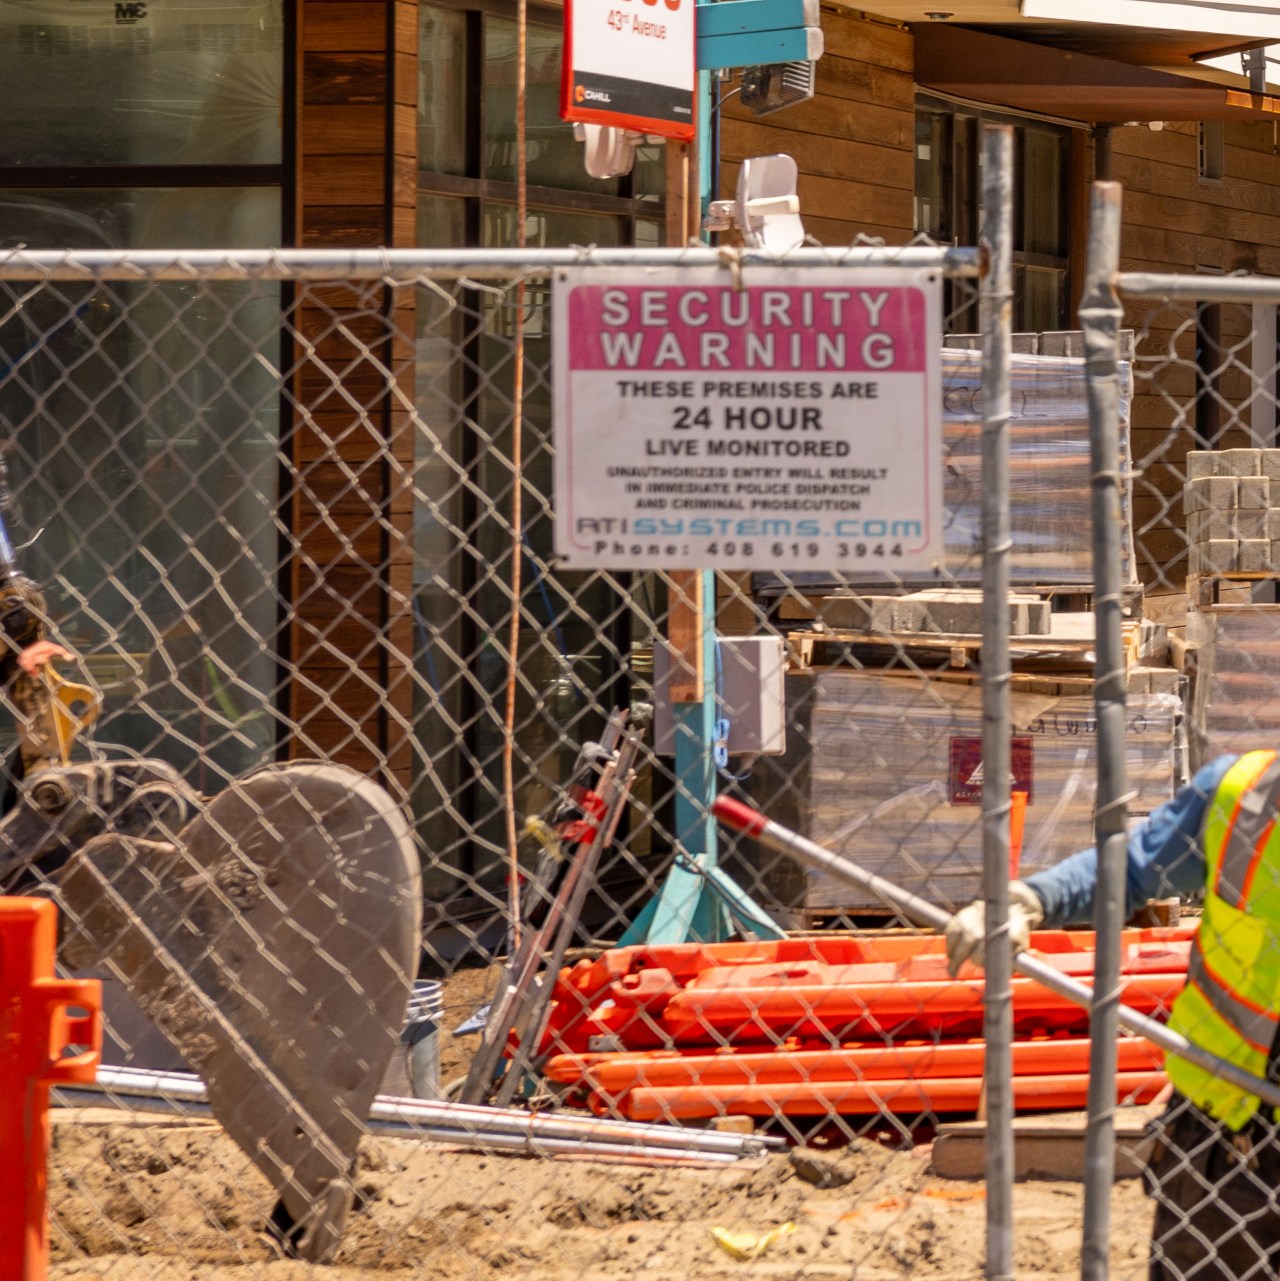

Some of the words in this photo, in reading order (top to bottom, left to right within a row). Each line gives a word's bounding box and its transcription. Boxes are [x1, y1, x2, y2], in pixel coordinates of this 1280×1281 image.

[632, 14, 666, 40] Avenue
[600, 291, 891, 327] SECURITY
[600, 331, 896, 369] WARNING
[616, 380, 695, 398] THESE
[703, 381, 823, 398] PREMISES
[830, 382, 879, 398] ARE
[672, 406, 712, 430] 24
[724, 406, 823, 430] HOUR
[645, 439, 699, 456] LIVE
[707, 440, 851, 457] MONITORED
[606, 466, 728, 478] UNAUTHORIZED
[733, 467, 783, 479] ENTRY
[788, 467, 825, 479] WILL
[829, 468, 888, 479] RESULT
[625, 482, 642, 493] IN
[646, 482, 730, 494] IMMEDIATE
[735, 483, 791, 495] POLICE
[796, 483, 871, 495] DISPATCH
[635, 498, 667, 509] AND
[671, 498, 745, 510] CRIMINAL
[750, 499, 861, 511] PROSECUTION
[593, 539, 690, 556] Phone:
[706, 541, 754, 557] 408
[771, 542, 820, 558] 619
[838, 542, 904, 558] 3944
